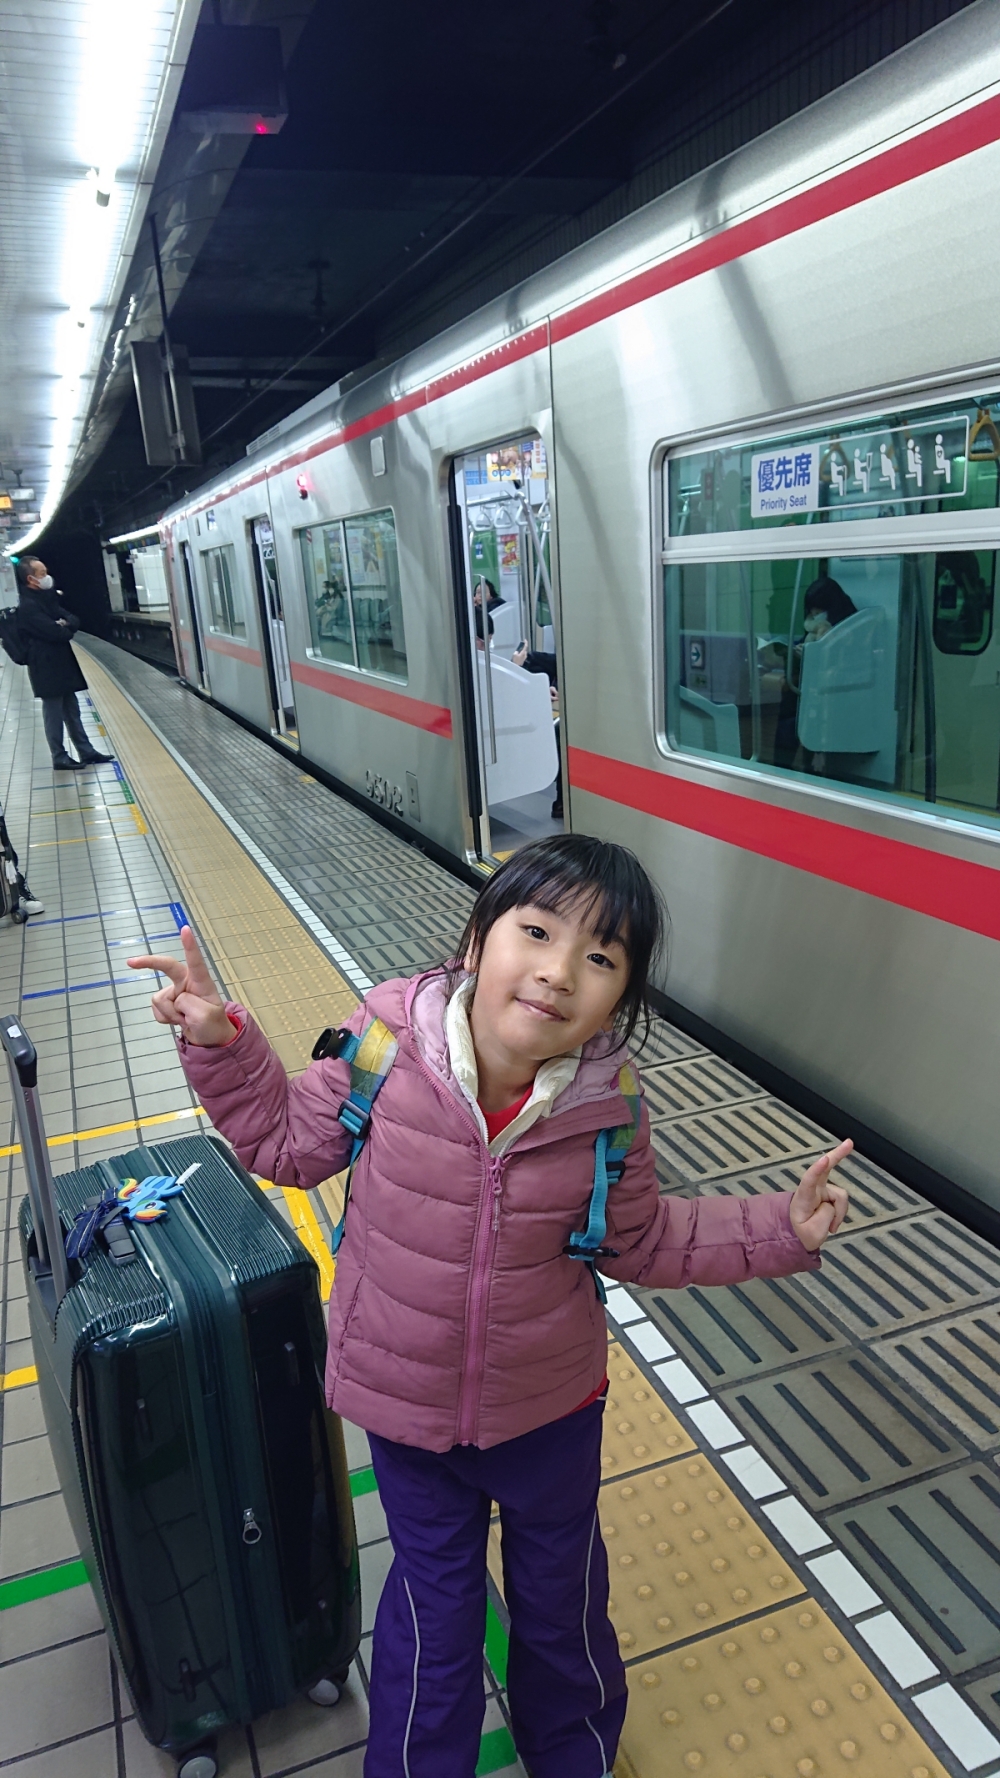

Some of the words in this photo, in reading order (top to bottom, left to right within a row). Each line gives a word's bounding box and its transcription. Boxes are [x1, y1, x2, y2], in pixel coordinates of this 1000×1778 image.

[758, 452, 812, 493] 優先席
[760, 497, 788, 511] Priority
[789, 494, 807, 507] Seat
